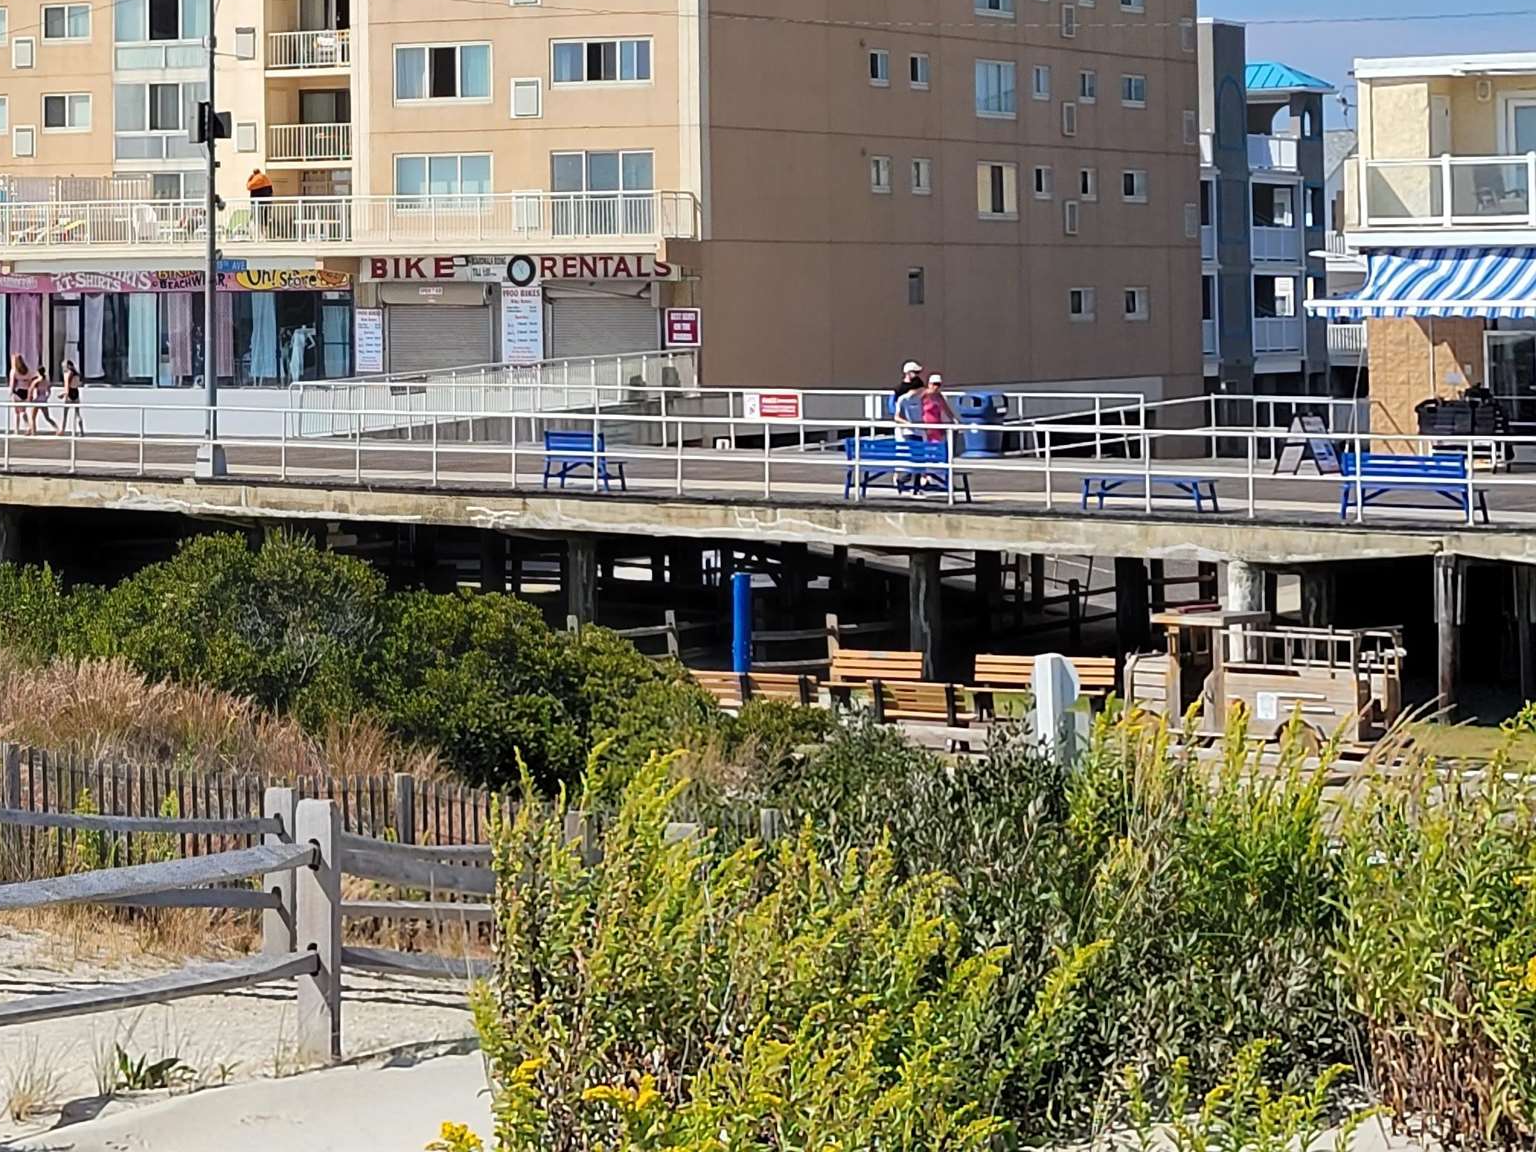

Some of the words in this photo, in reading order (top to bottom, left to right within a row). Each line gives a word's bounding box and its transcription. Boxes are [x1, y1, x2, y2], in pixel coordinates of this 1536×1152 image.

[232, 260, 246, 271] AVE
[371, 257, 456, 279] BIKE
[540, 256, 672, 279] RENTALS
[280, 271, 317, 288] Store
